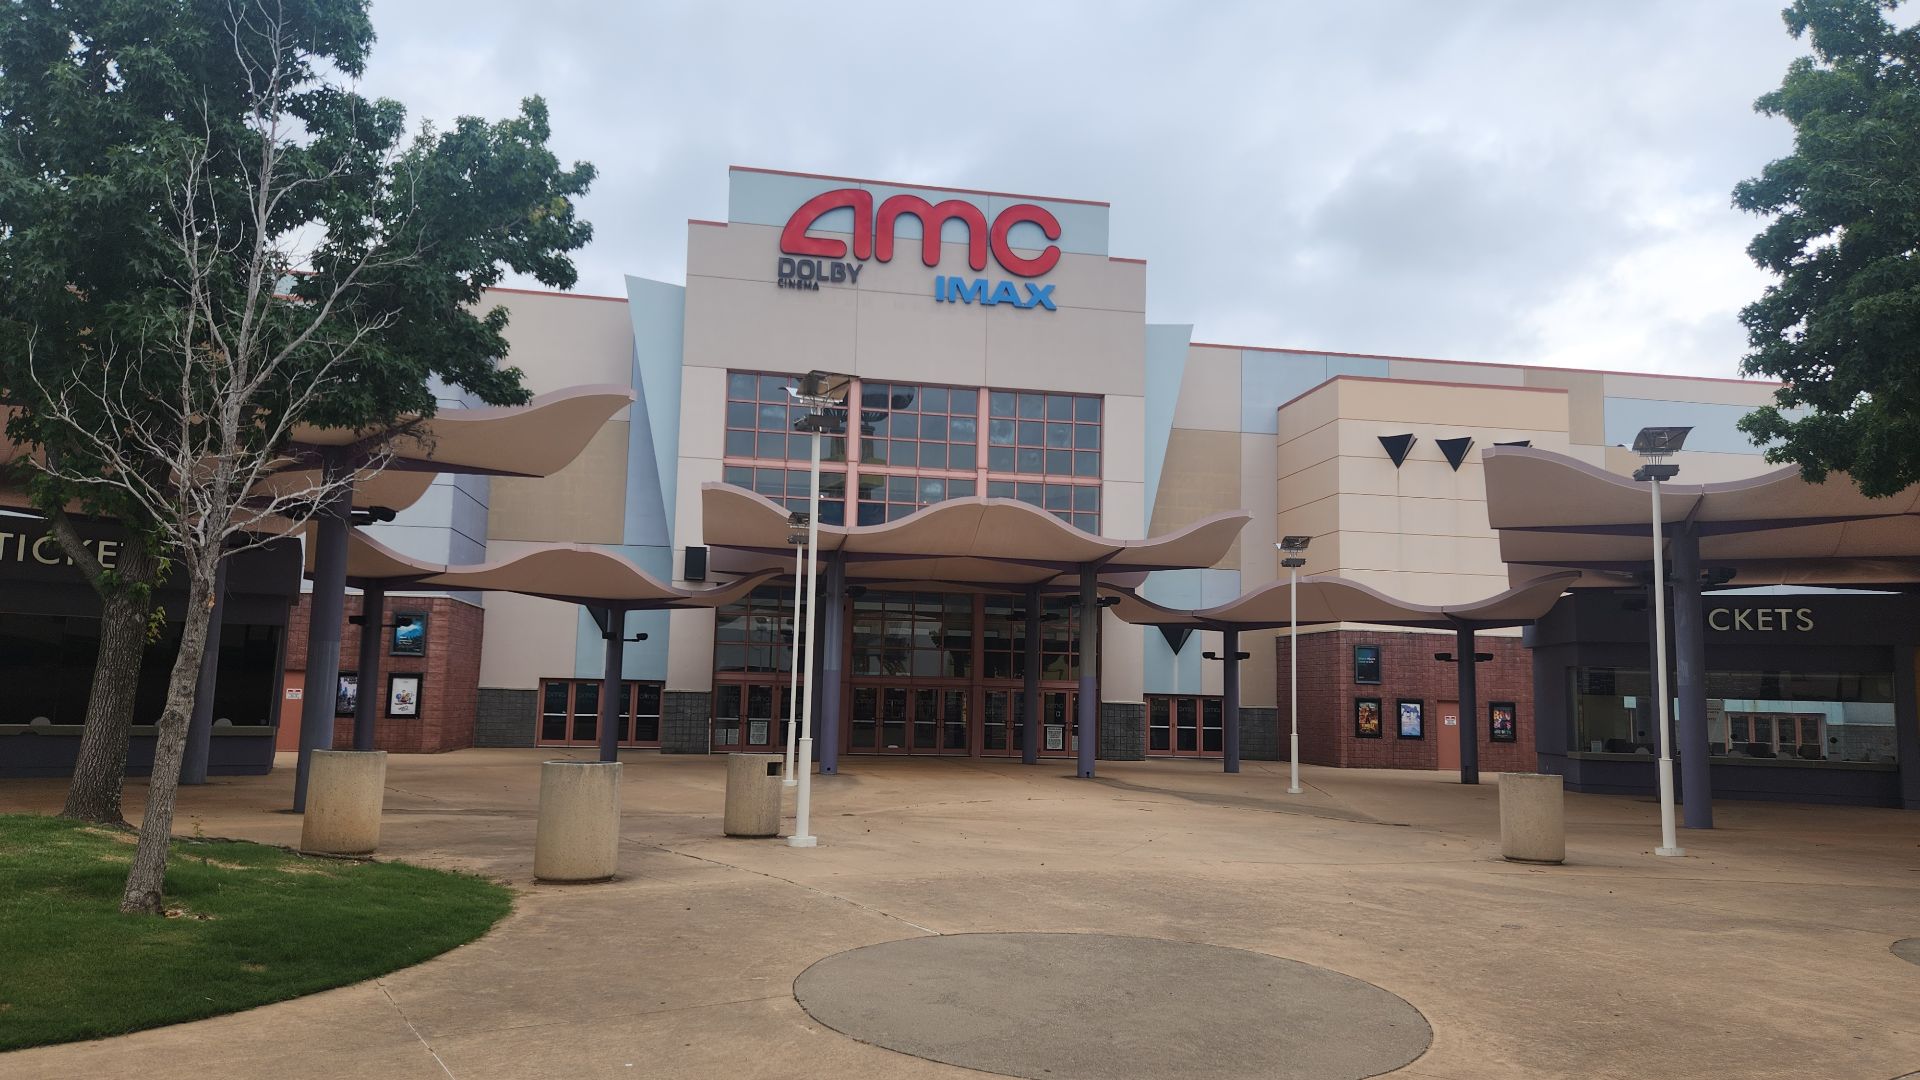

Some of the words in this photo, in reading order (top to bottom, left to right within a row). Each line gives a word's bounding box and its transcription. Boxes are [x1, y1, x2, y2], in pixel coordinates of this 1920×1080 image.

[777, 257, 863, 285] DOLBY
[777, 279, 820, 291] CINEMA
[934, 275, 1058, 311] IMAX
[0, 532, 124, 569] TICE
[1708, 607, 1815, 632] CKETS
